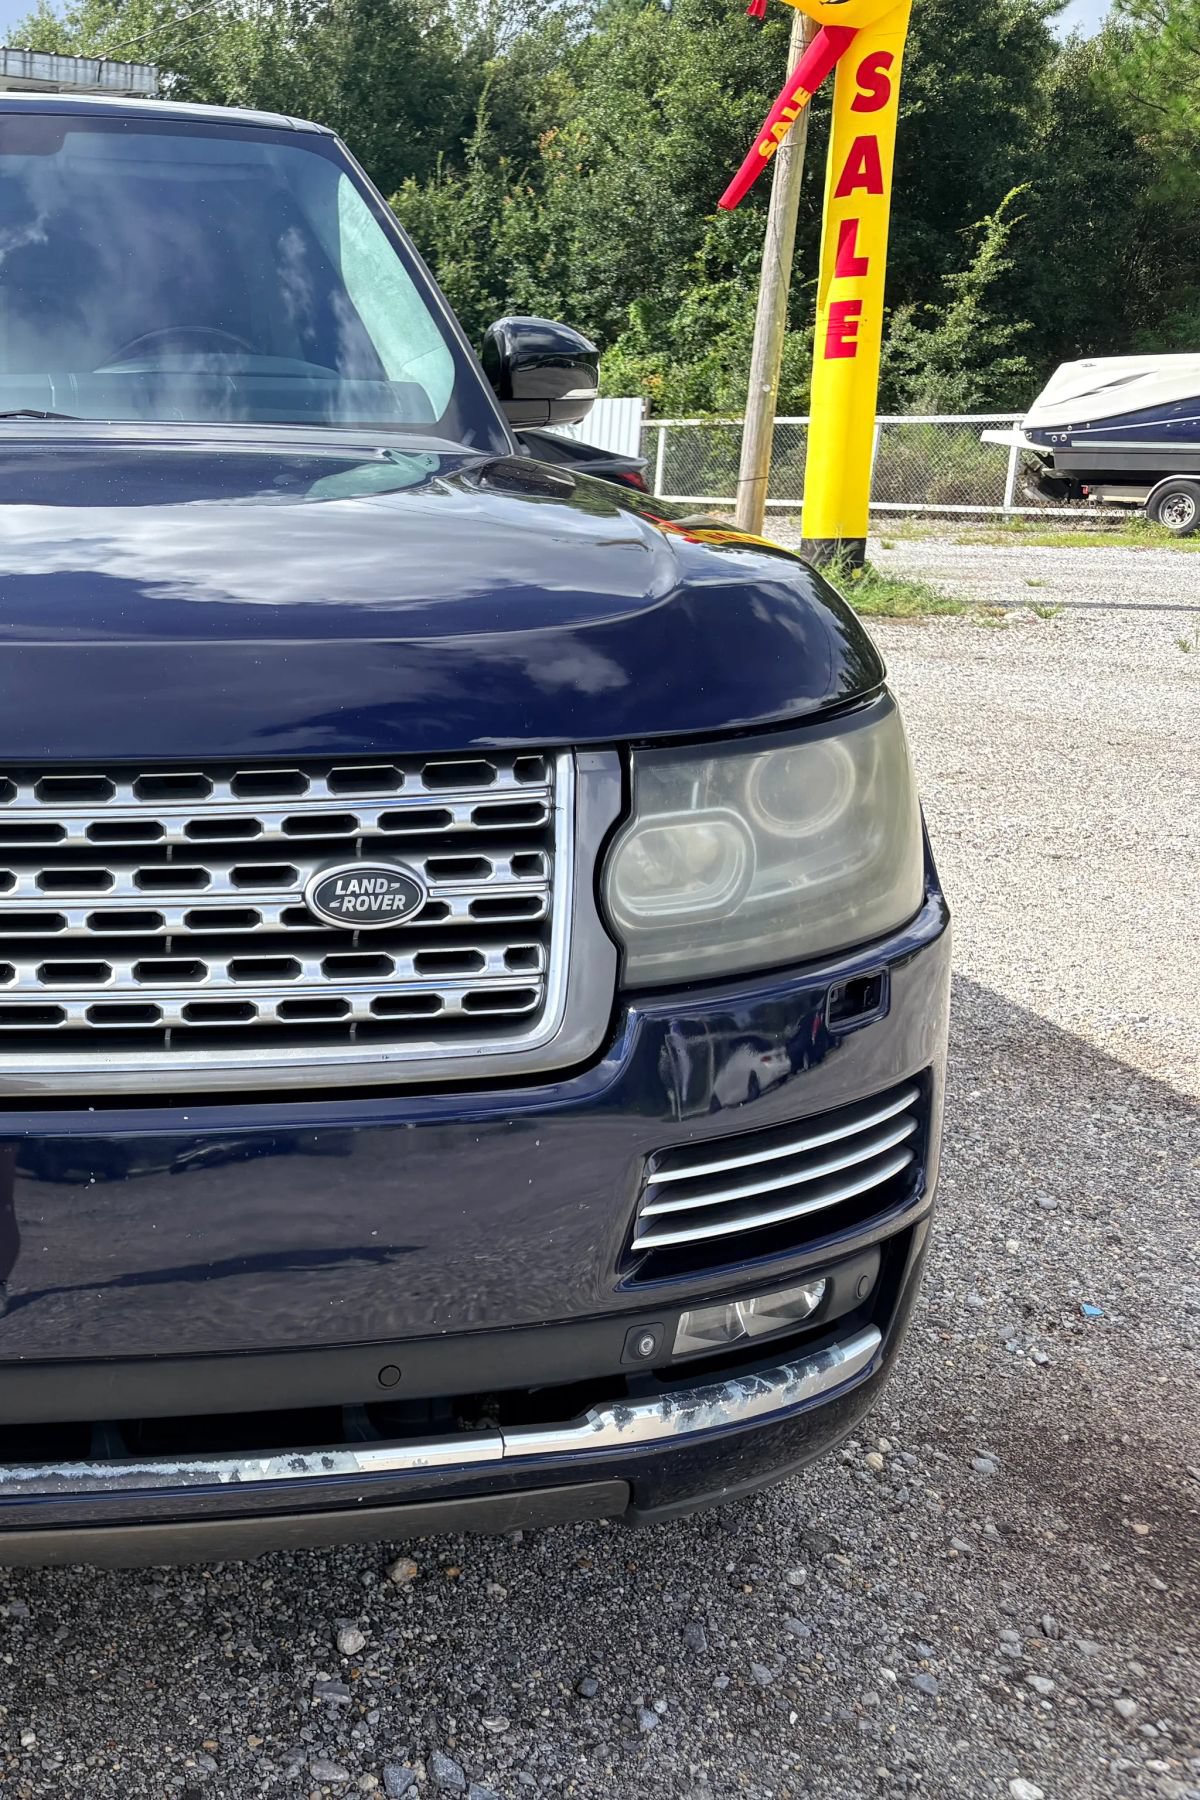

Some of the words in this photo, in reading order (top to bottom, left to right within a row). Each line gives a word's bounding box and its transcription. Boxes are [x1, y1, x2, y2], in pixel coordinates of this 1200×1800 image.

[758, 86, 813, 160] SALE
[823, 50, 895, 360] SALE
[335, 878, 388, 895] LAND
[341, 894, 406, 912] ROVER
